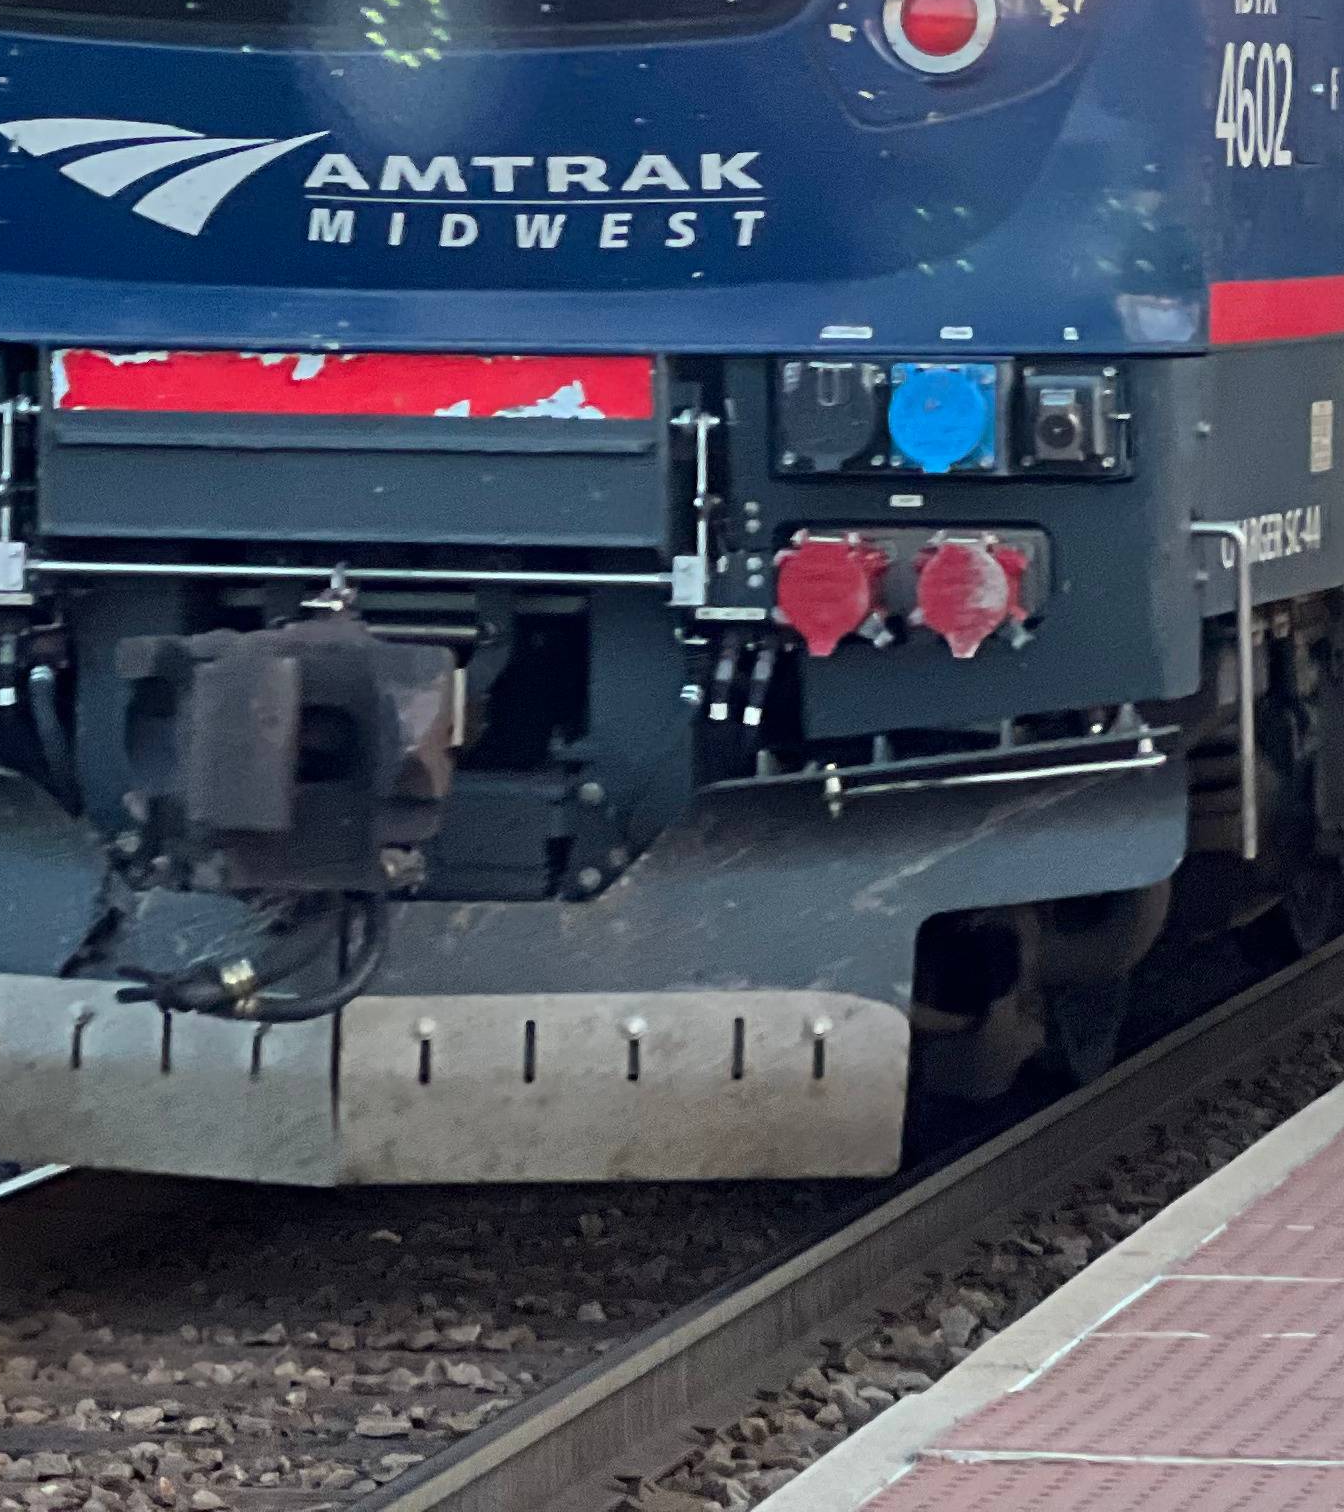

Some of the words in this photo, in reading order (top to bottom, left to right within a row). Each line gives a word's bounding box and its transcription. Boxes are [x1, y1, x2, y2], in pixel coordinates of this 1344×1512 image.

[1215, 40, 1293, 168] 4602
[304, 152, 763, 192] AMTRAK
[307, 208, 765, 249] MIDWEST
